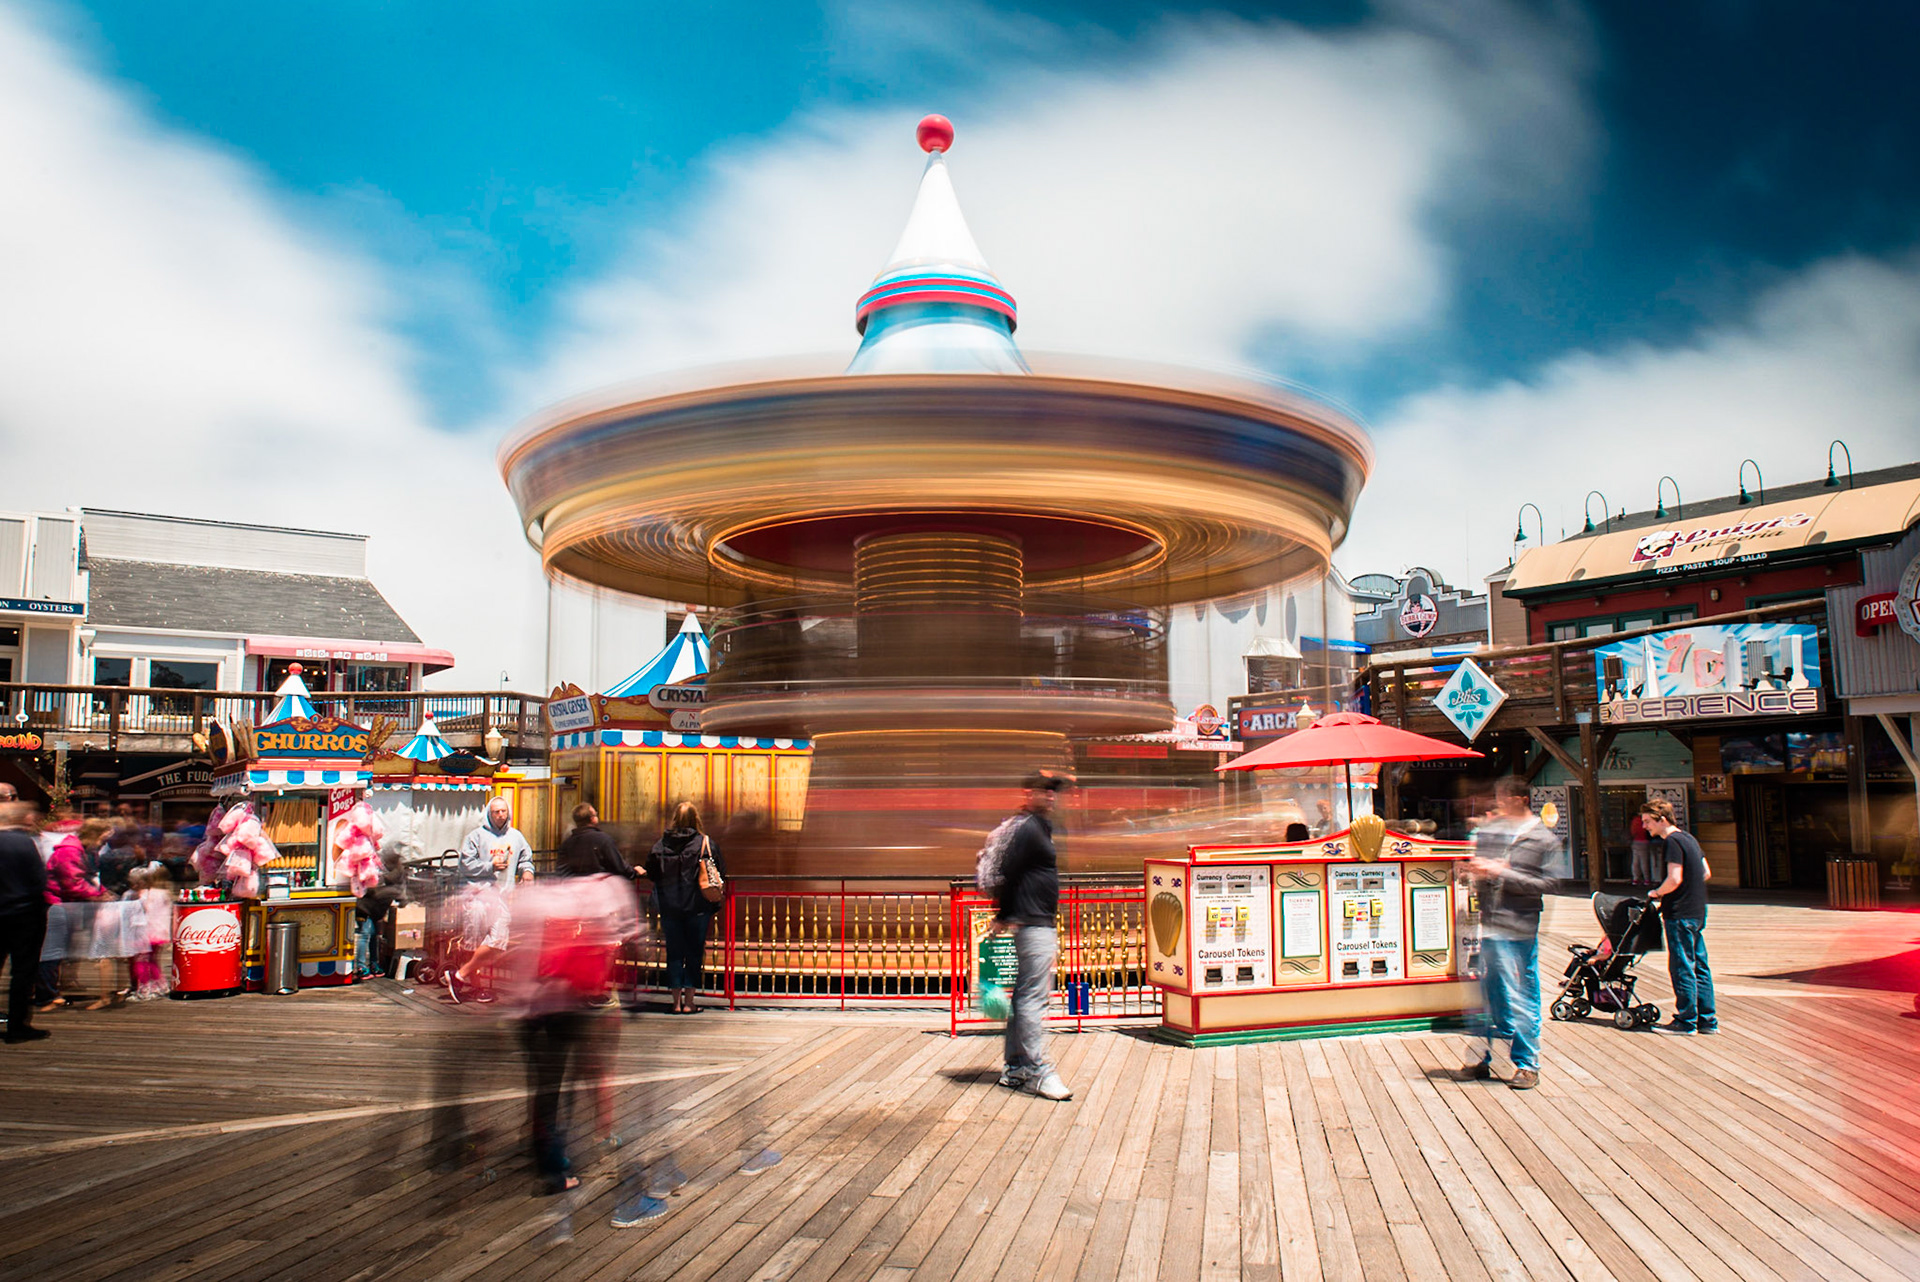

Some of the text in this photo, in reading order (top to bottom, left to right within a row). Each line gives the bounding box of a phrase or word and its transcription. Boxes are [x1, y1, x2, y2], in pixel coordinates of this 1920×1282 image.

[1690, 530, 1785, 553] pizzeria
[1656, 552, 1768, 575] PIZZA PASTA SOUP SALAD
[29, 602, 75, 613] OYSTERS
[1451, 688, 1481, 705] Bliss
[549, 697, 589, 717] CRYSTAL GEYSER
[1600, 689, 1818, 724] EXPERIENCE
[679, 719, 701, 729] ALPIN
[254, 731, 369, 752] CHURROS
[157, 770, 214, 787] THE FUDG
[333, 796, 354, 814] Dogs
[180, 923, 238, 945] Coca-Cola
[1198, 948, 1266, 959] Carousel Tokens
[1336, 940, 1398, 951] Carousel Tokens
